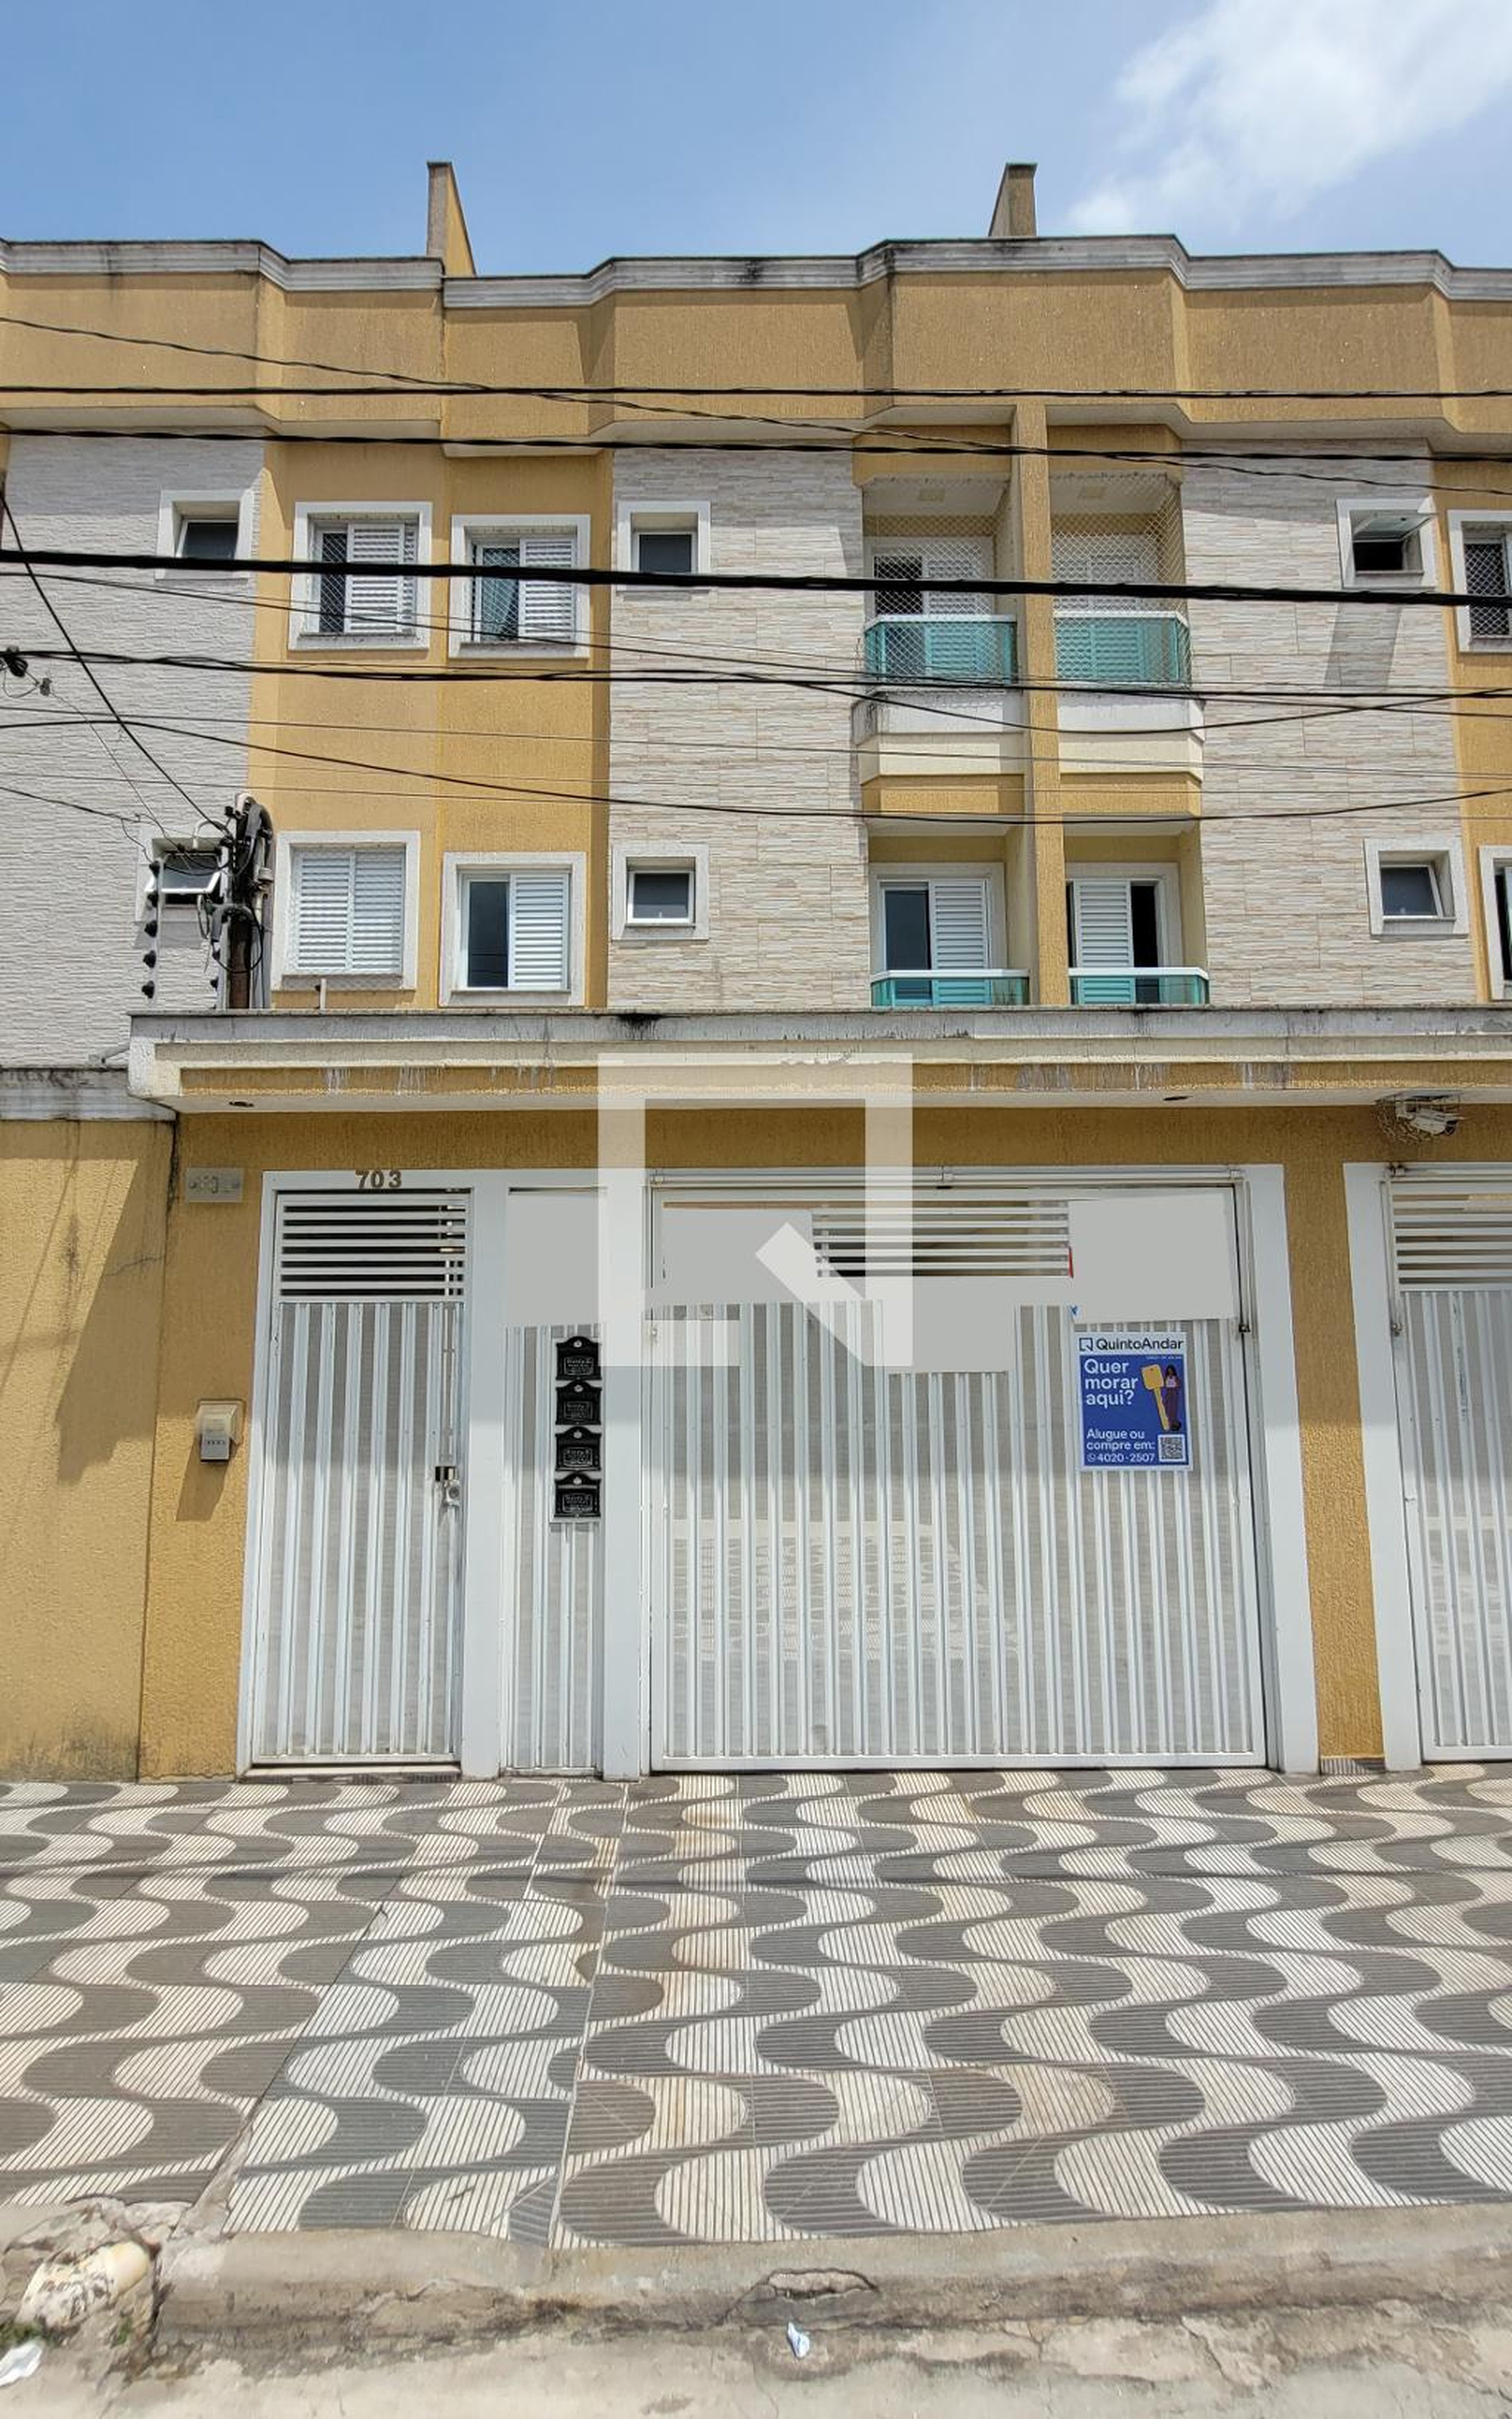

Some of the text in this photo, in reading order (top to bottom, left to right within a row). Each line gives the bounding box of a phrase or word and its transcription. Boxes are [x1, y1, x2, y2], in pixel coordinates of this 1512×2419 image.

[355, 1169, 402, 1189] 703
[1096, 1338, 1184, 1351] QuintoAndar
[1084, 1358, 1129, 1374] Quer
[1085, 1378, 1138, 1389] morar
[1086, 1390, 1134, 1409] aqui?
[1086, 1428, 1145, 1442] Alugue ou
[1086, 1442, 1155, 1452] compre em:
